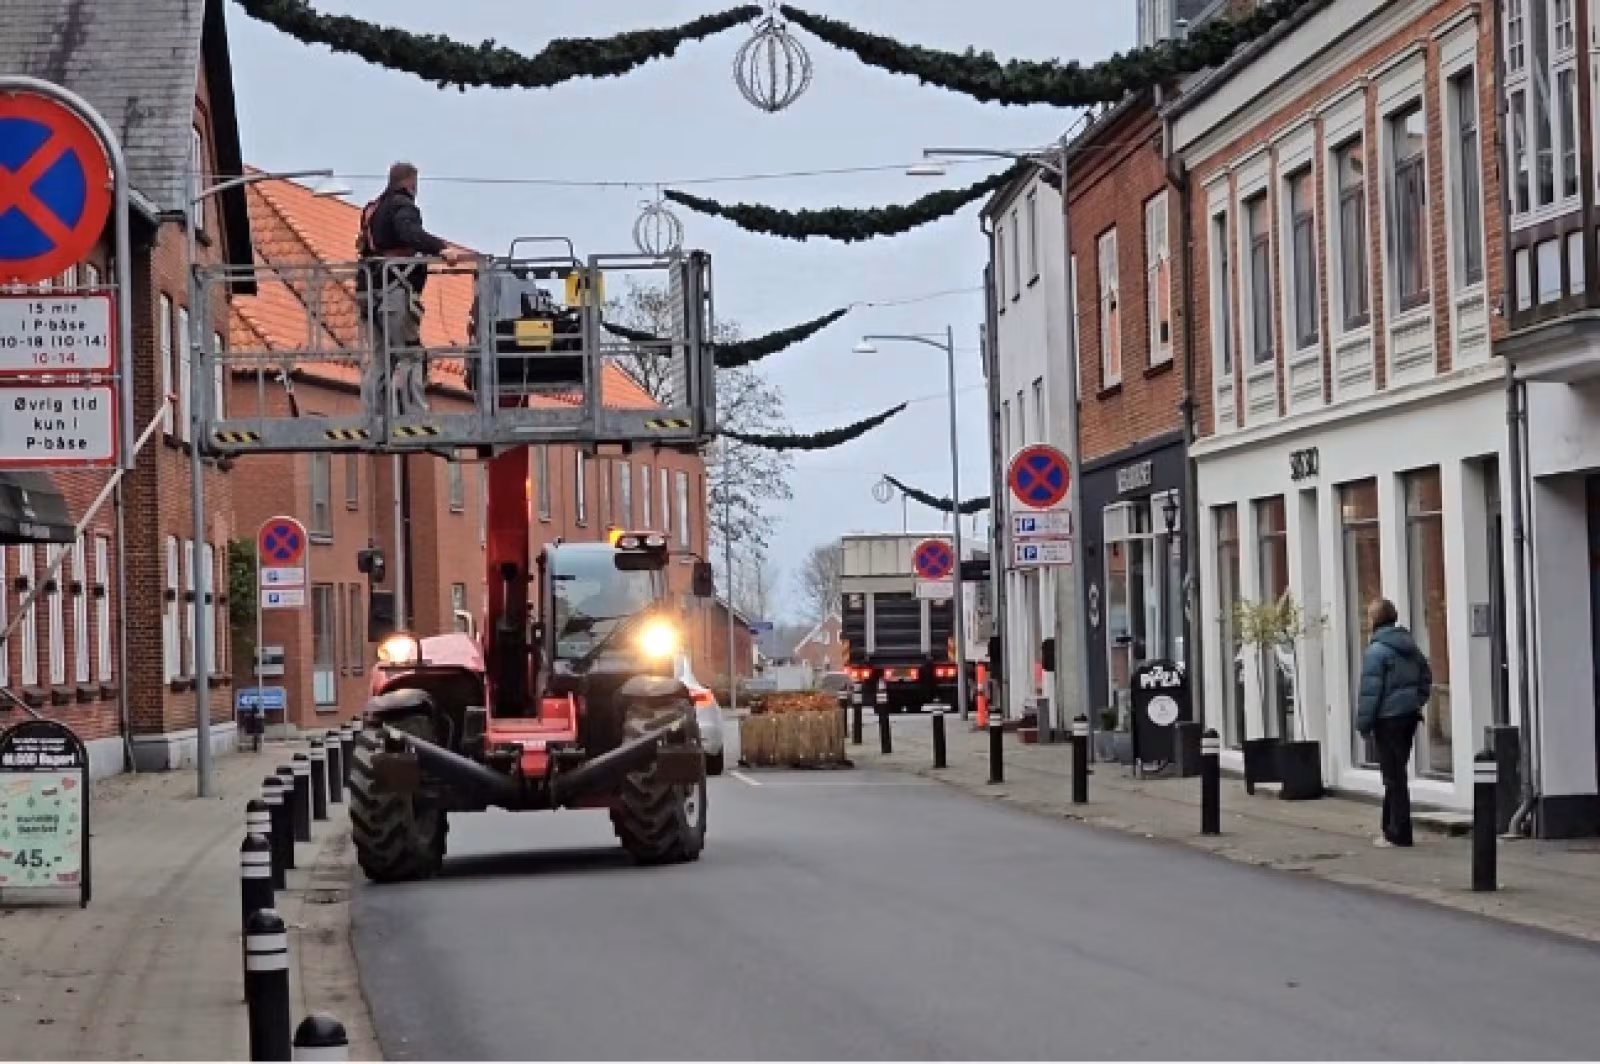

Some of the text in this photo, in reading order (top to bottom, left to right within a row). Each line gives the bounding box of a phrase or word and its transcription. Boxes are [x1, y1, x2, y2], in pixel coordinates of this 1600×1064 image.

[29, 303, 44, 314] 15
[14, 397, 97, 413] Øvrig tid
[34, 417, 65, 430] kun
[26, 437, 87, 450] P-båse
